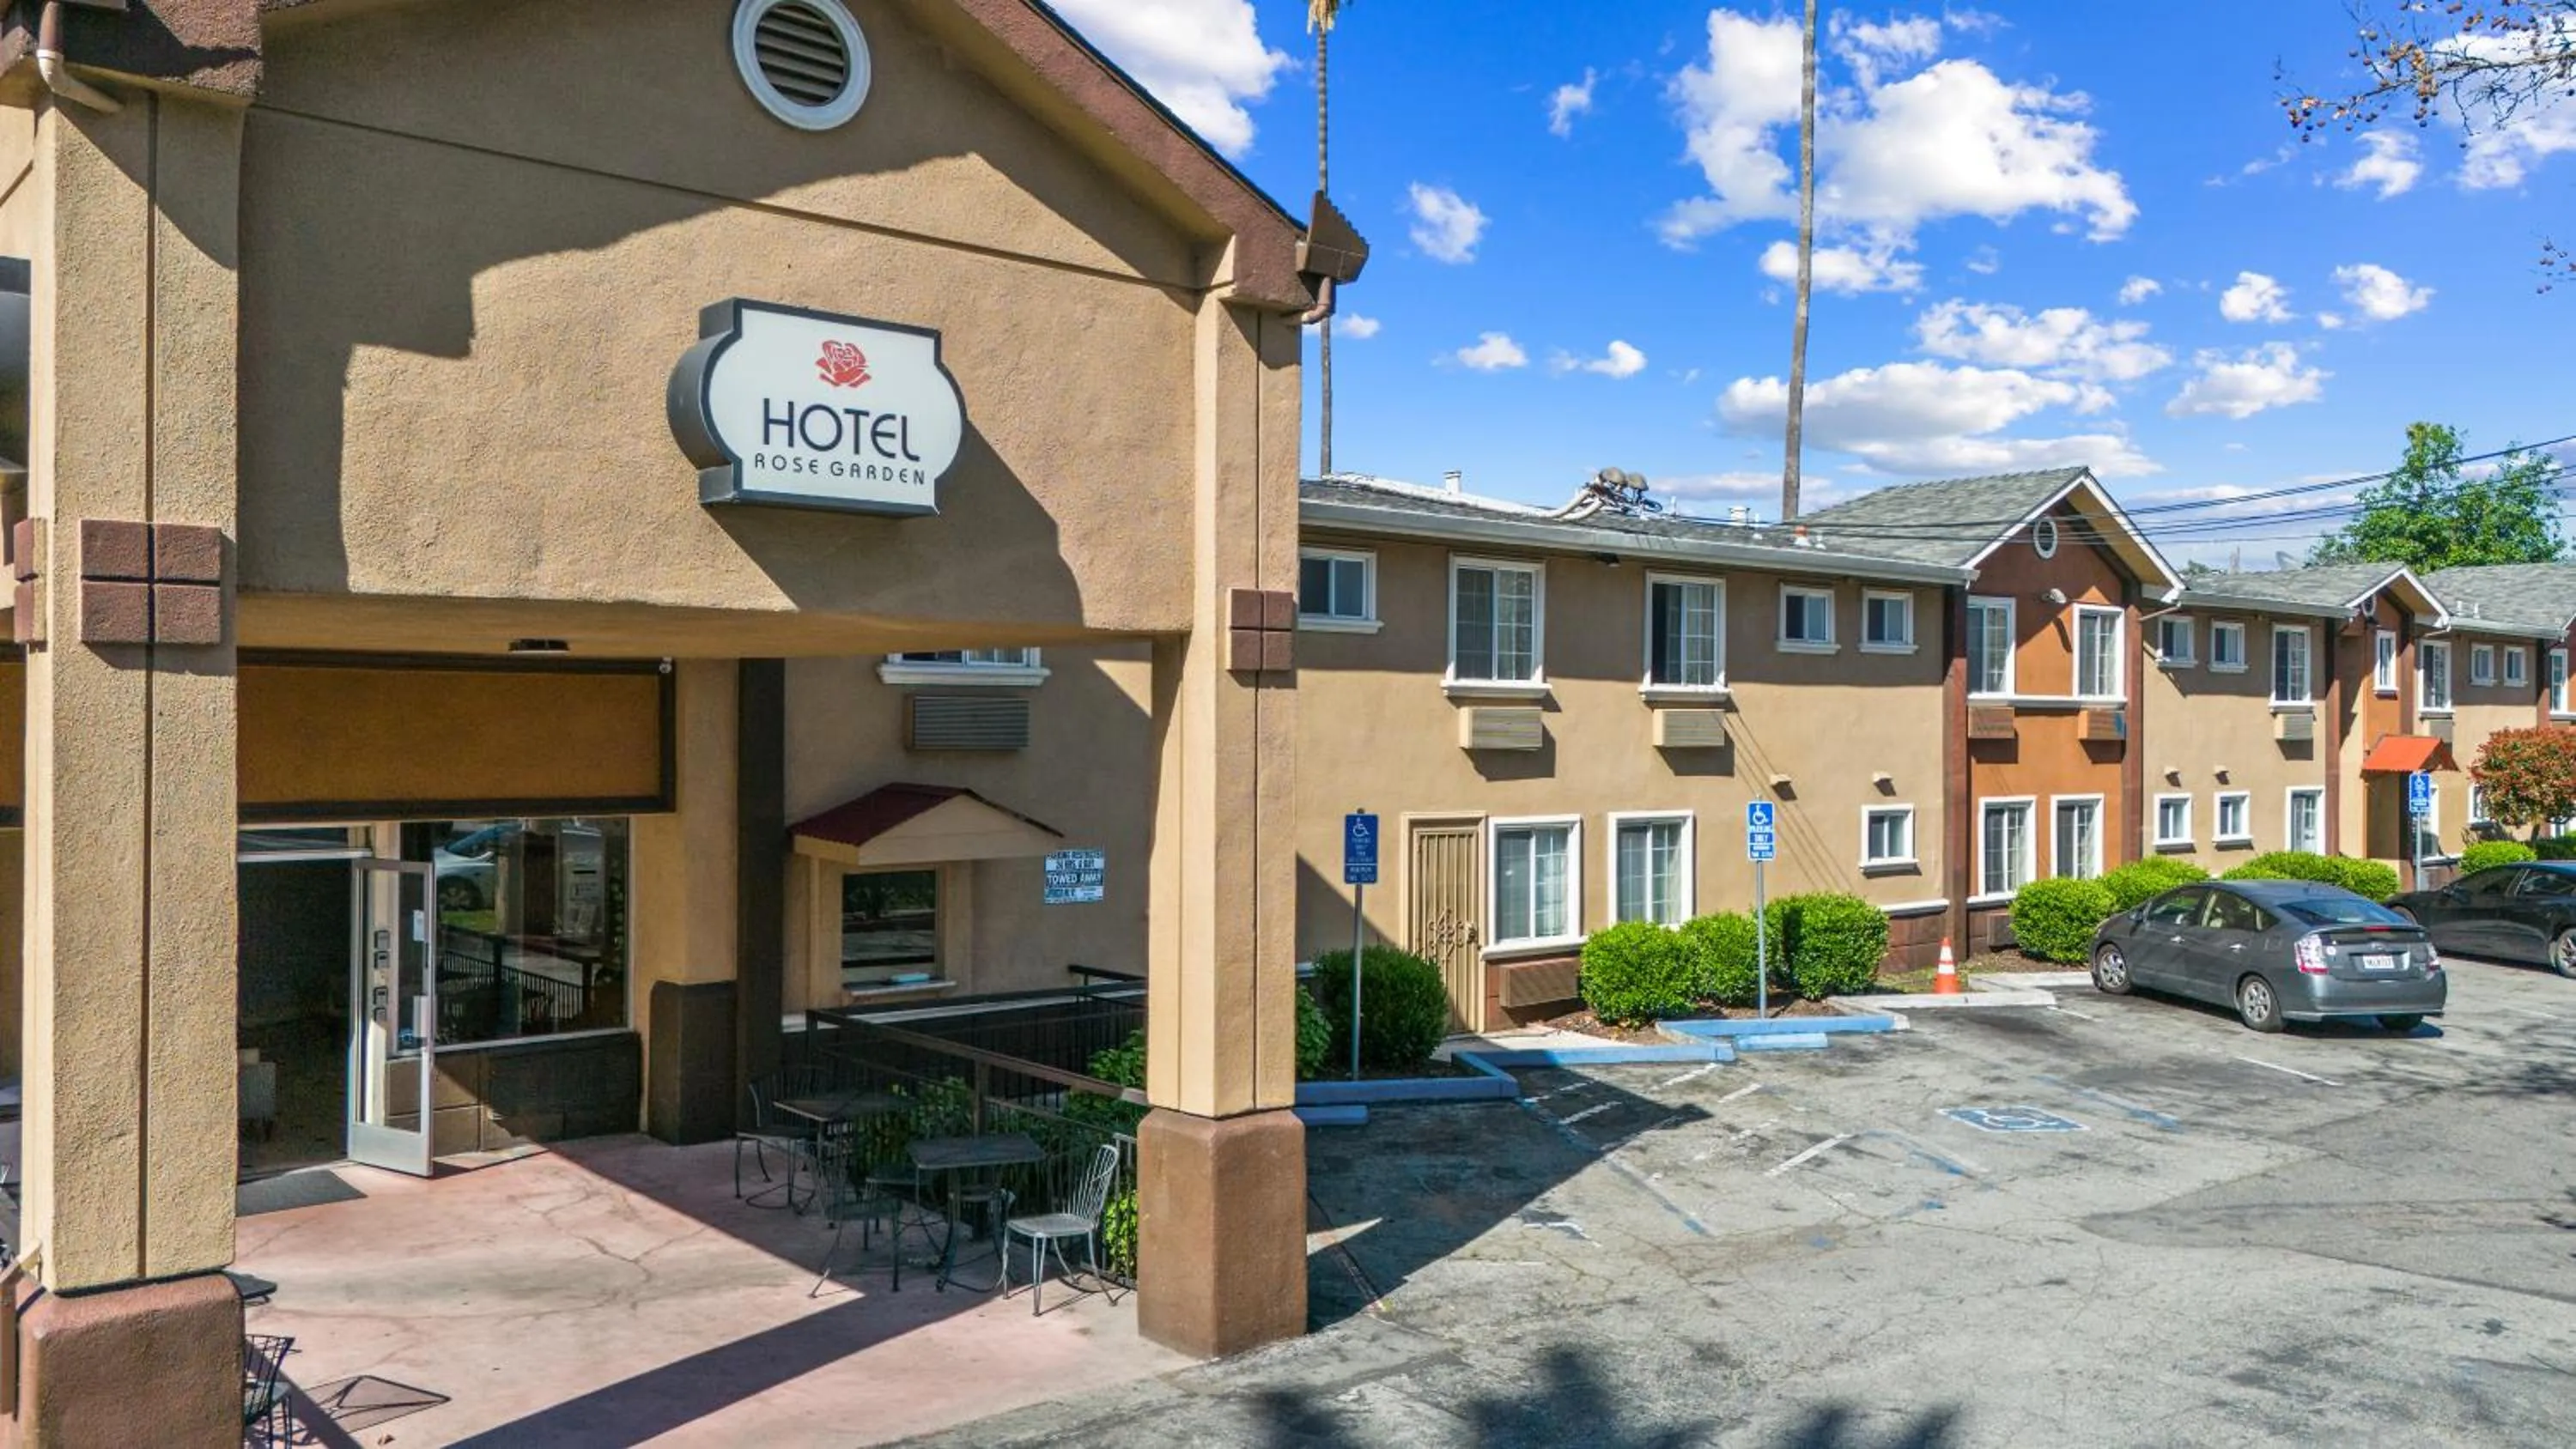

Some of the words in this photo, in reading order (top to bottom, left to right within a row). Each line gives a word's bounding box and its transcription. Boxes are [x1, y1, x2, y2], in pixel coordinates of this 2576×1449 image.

[763, 397, 920, 462] HOTEL
[755, 452, 818, 474] ROSE
[830, 461, 925, 485] GARDEN
[1047, 874, 1078, 884] TOWED
